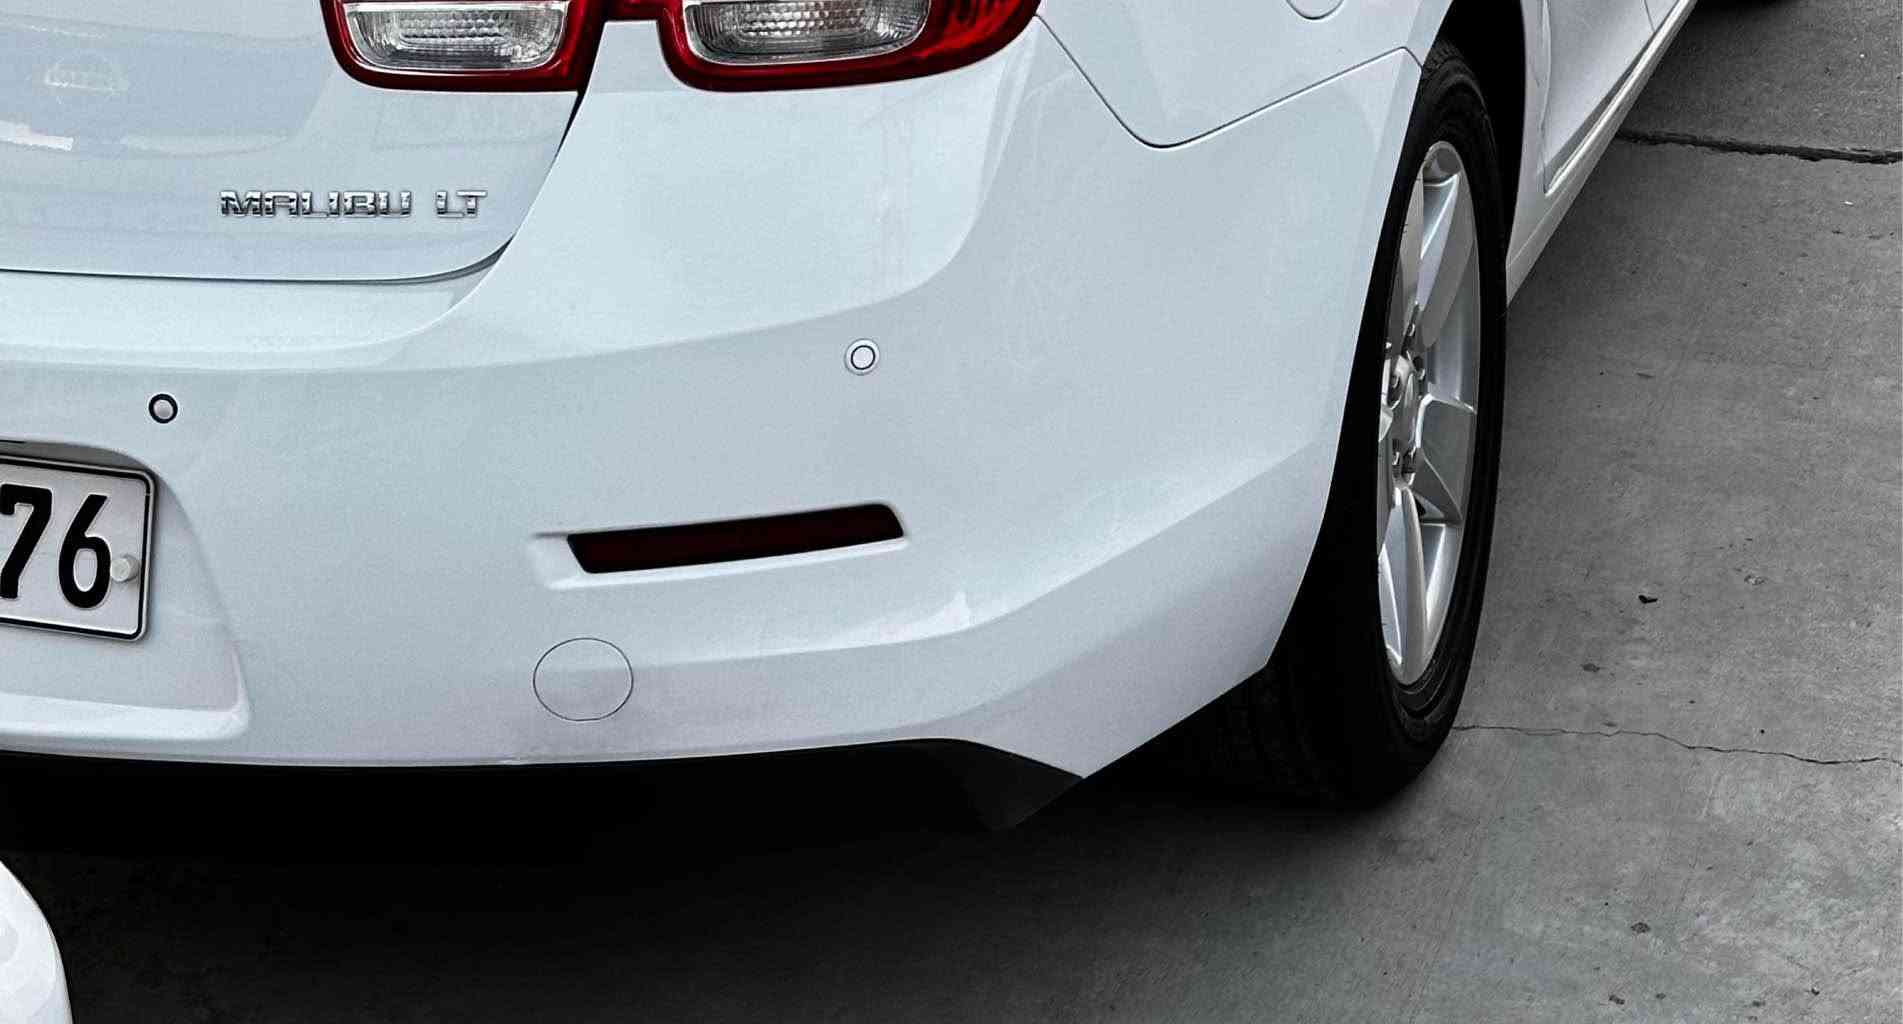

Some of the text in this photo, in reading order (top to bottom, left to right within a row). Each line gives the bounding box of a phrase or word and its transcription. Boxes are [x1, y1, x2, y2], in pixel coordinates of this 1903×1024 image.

[219, 189, 489, 219] MALIBU LT
[0, 483, 112, 609] 76
